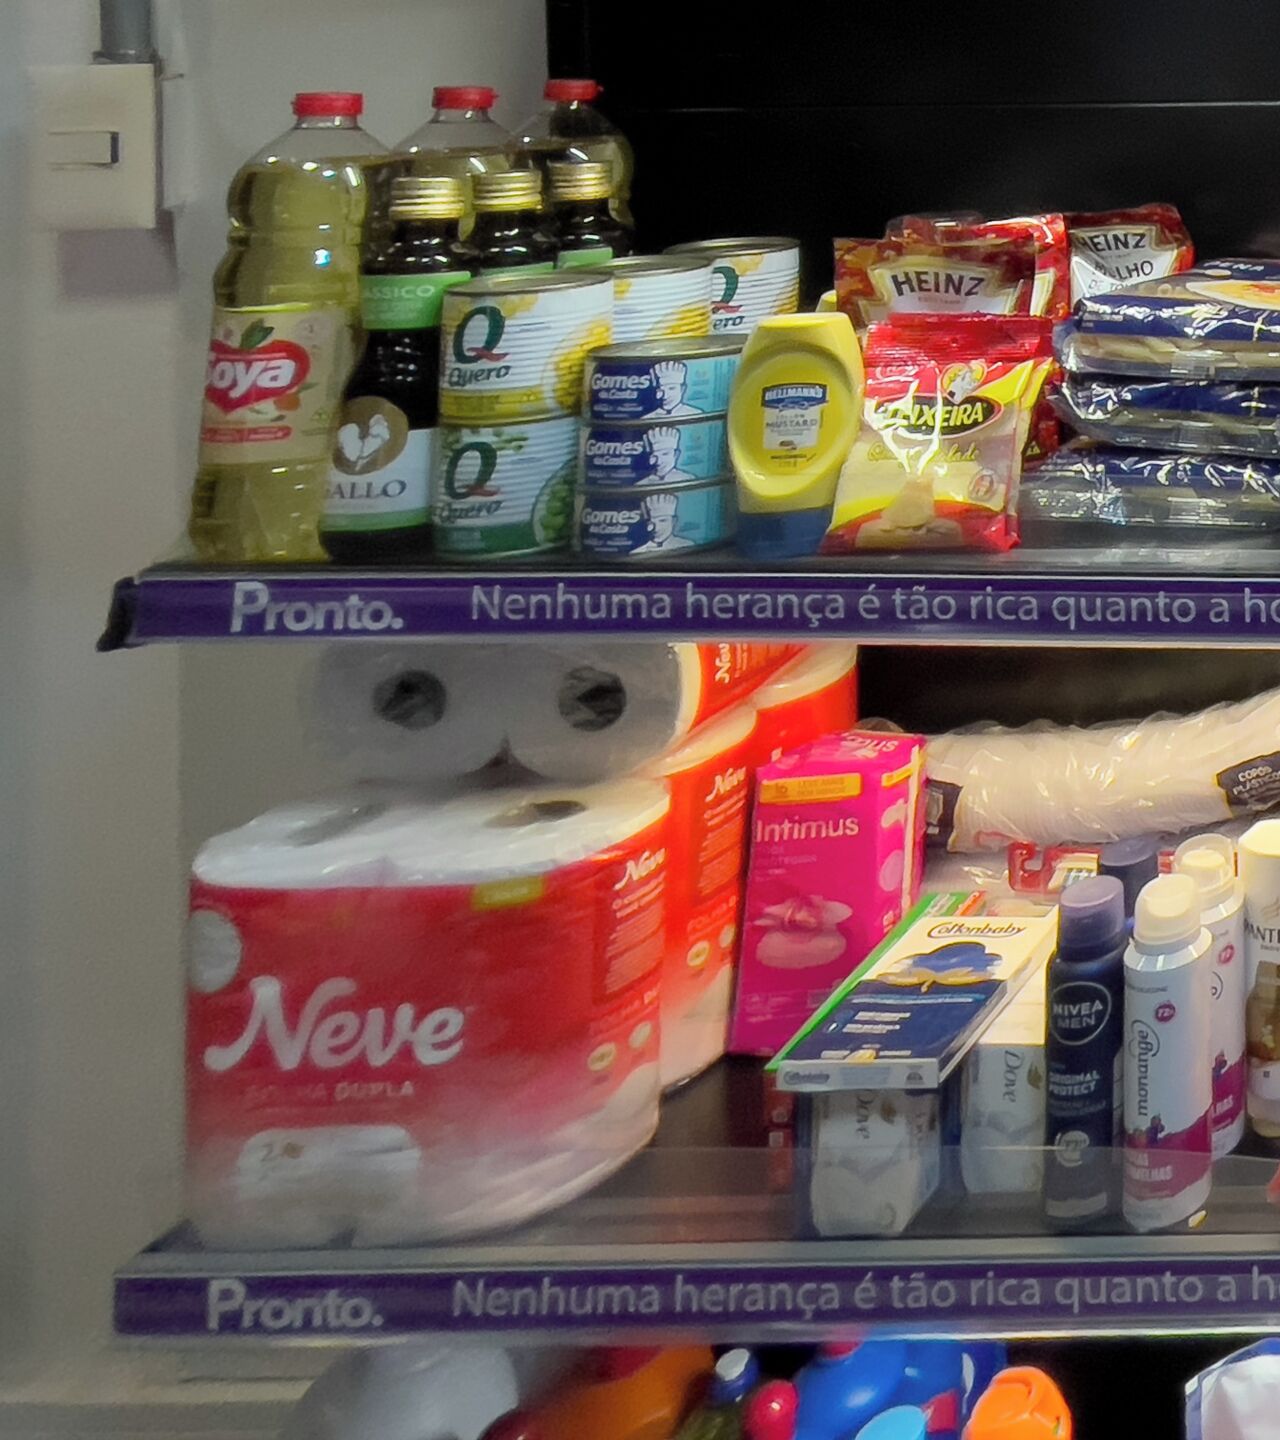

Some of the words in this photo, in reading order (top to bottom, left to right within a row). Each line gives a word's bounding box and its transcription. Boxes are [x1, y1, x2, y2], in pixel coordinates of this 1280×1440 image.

[1078, 231, 1147, 253] HEINZ
[893, 270, 986, 298] HEINZ
[448, 364, 512, 386] Quero
[591, 373, 652, 389] Gomes
[764, 386, 824, 401] HELLMANN'S
[585, 439, 645, 455] Gomes
[582, 509, 642, 524] Gomes
[231, 580, 405, 632] Pronto.
[470, 586, 672, 621] Nenhuma
[685, 584, 846, 627] herança
[857, 586, 878, 620] é
[891, 586, 957, 621] tão
[969, 585, 1039, 621] rica
[1051, 591, 1197, 629] quanto
[1208, 596, 1231, 624] a
[754, 815, 860, 844] Intimus
[926, 920, 1028, 940] Cottonbaby
[1053, 999, 1104, 1017] NIVEA
[203, 975, 468, 1074] Neve
[1056, 1015, 1096, 1030] MEN
[207, 1279, 385, 1331] Pronto.
